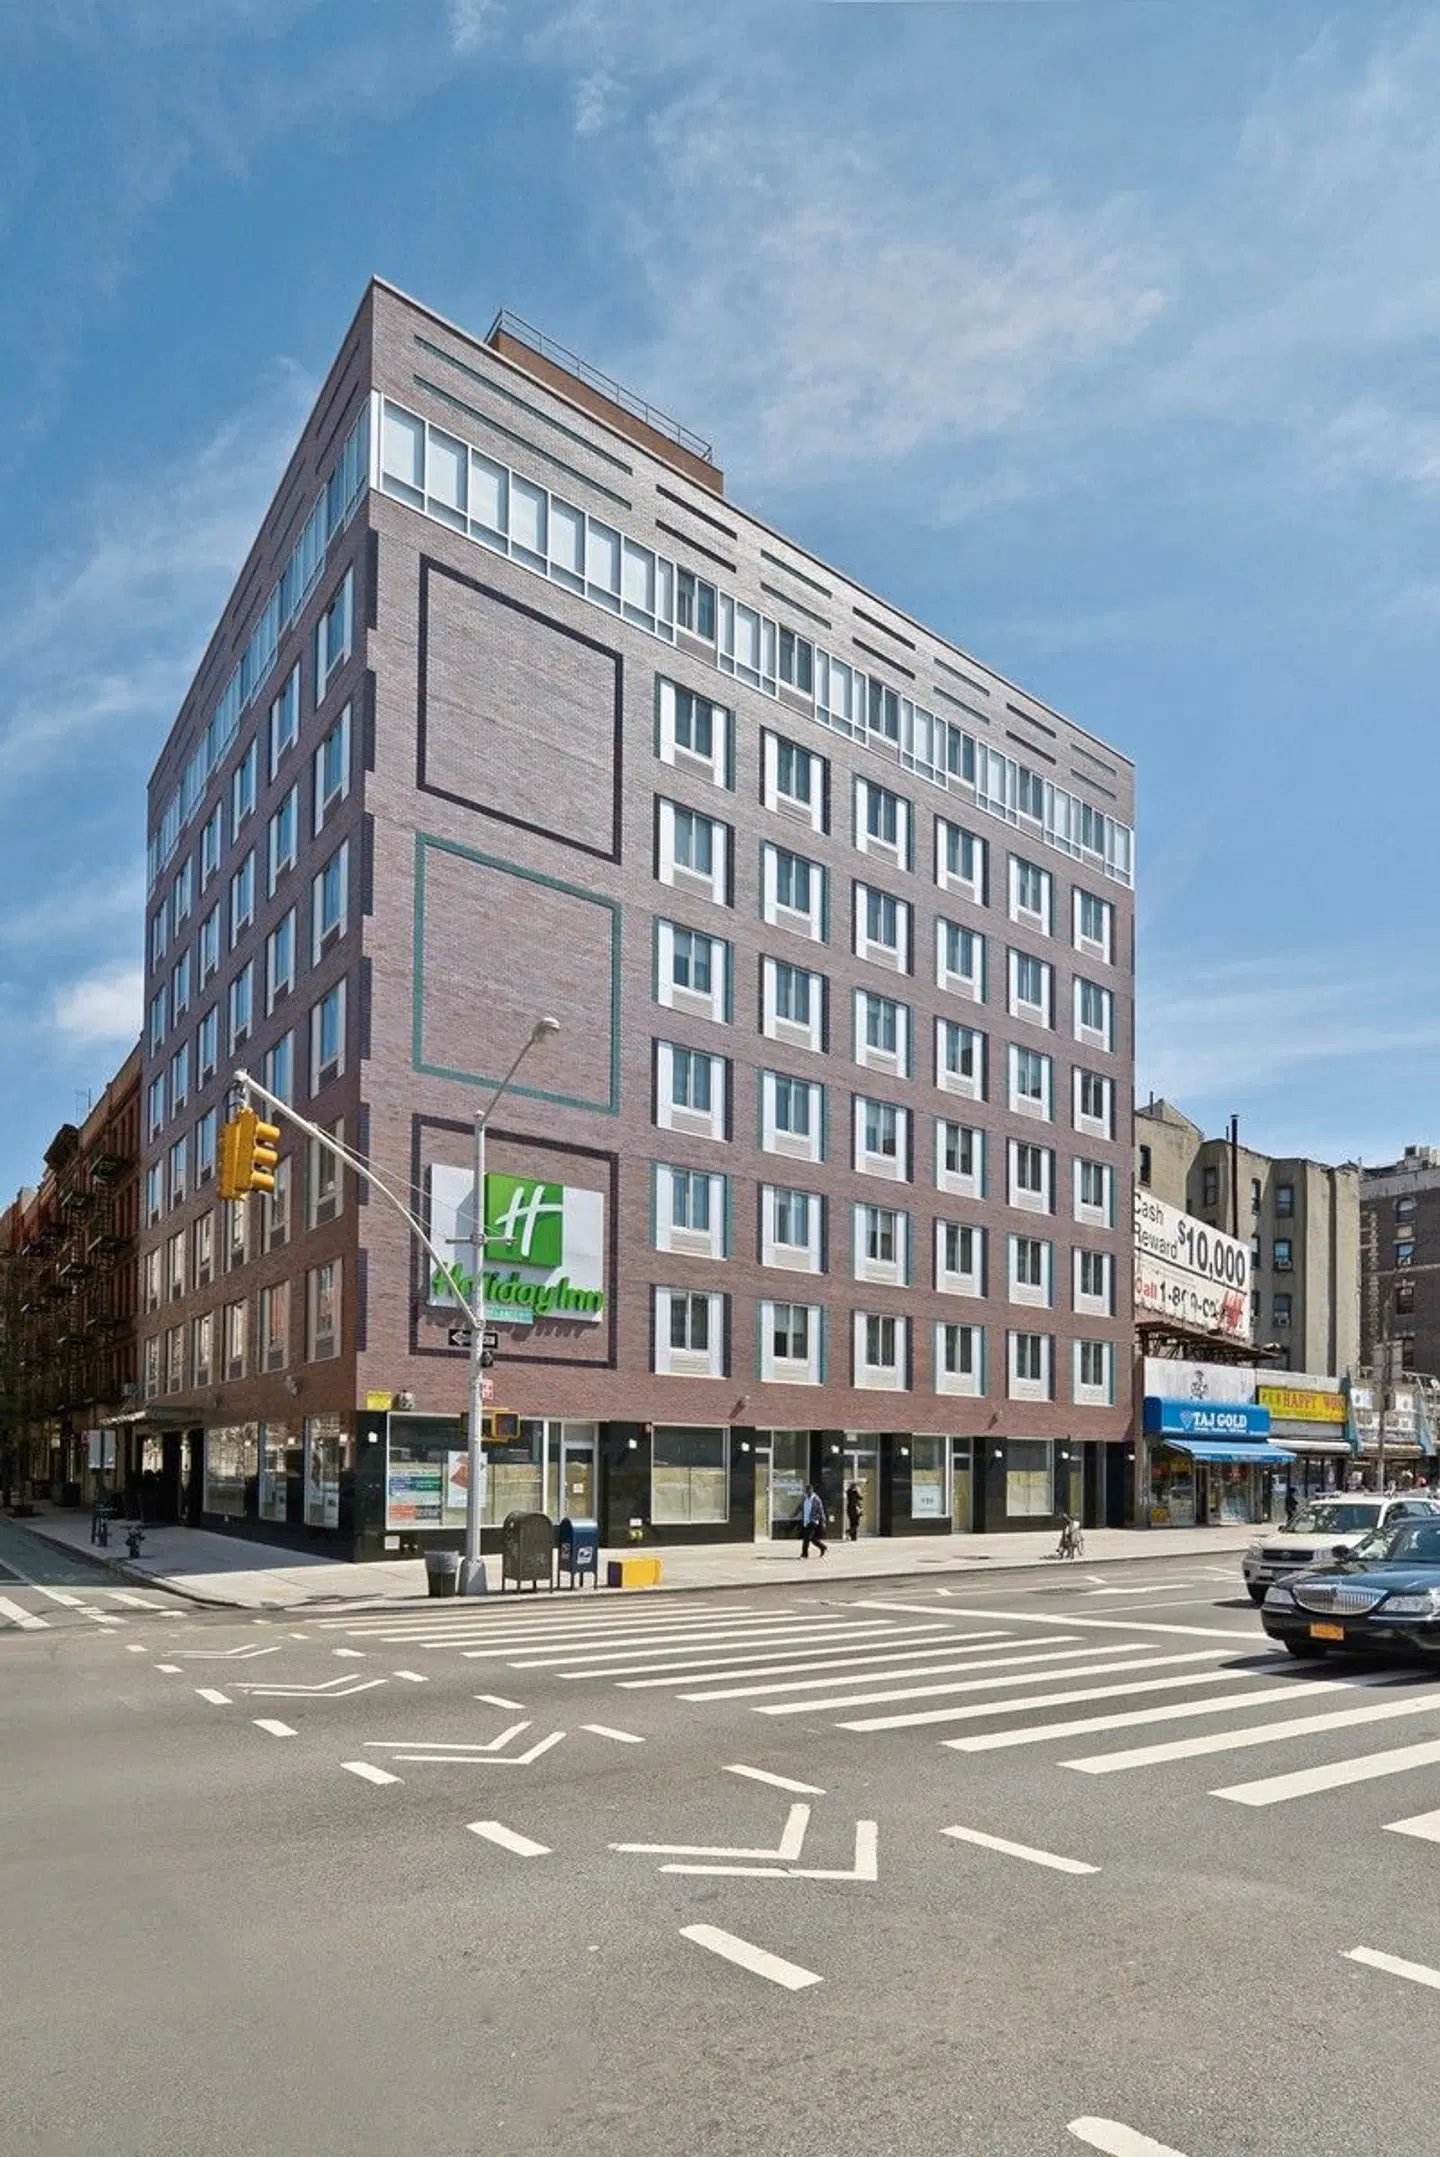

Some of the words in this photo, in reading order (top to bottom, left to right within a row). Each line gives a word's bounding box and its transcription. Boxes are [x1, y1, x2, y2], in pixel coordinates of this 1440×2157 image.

[1177, 1219, 1246, 1288] $10,000
[1193, 1411, 1215, 1427] TAJ
[1216, 1412, 1248, 1428] GOLD
